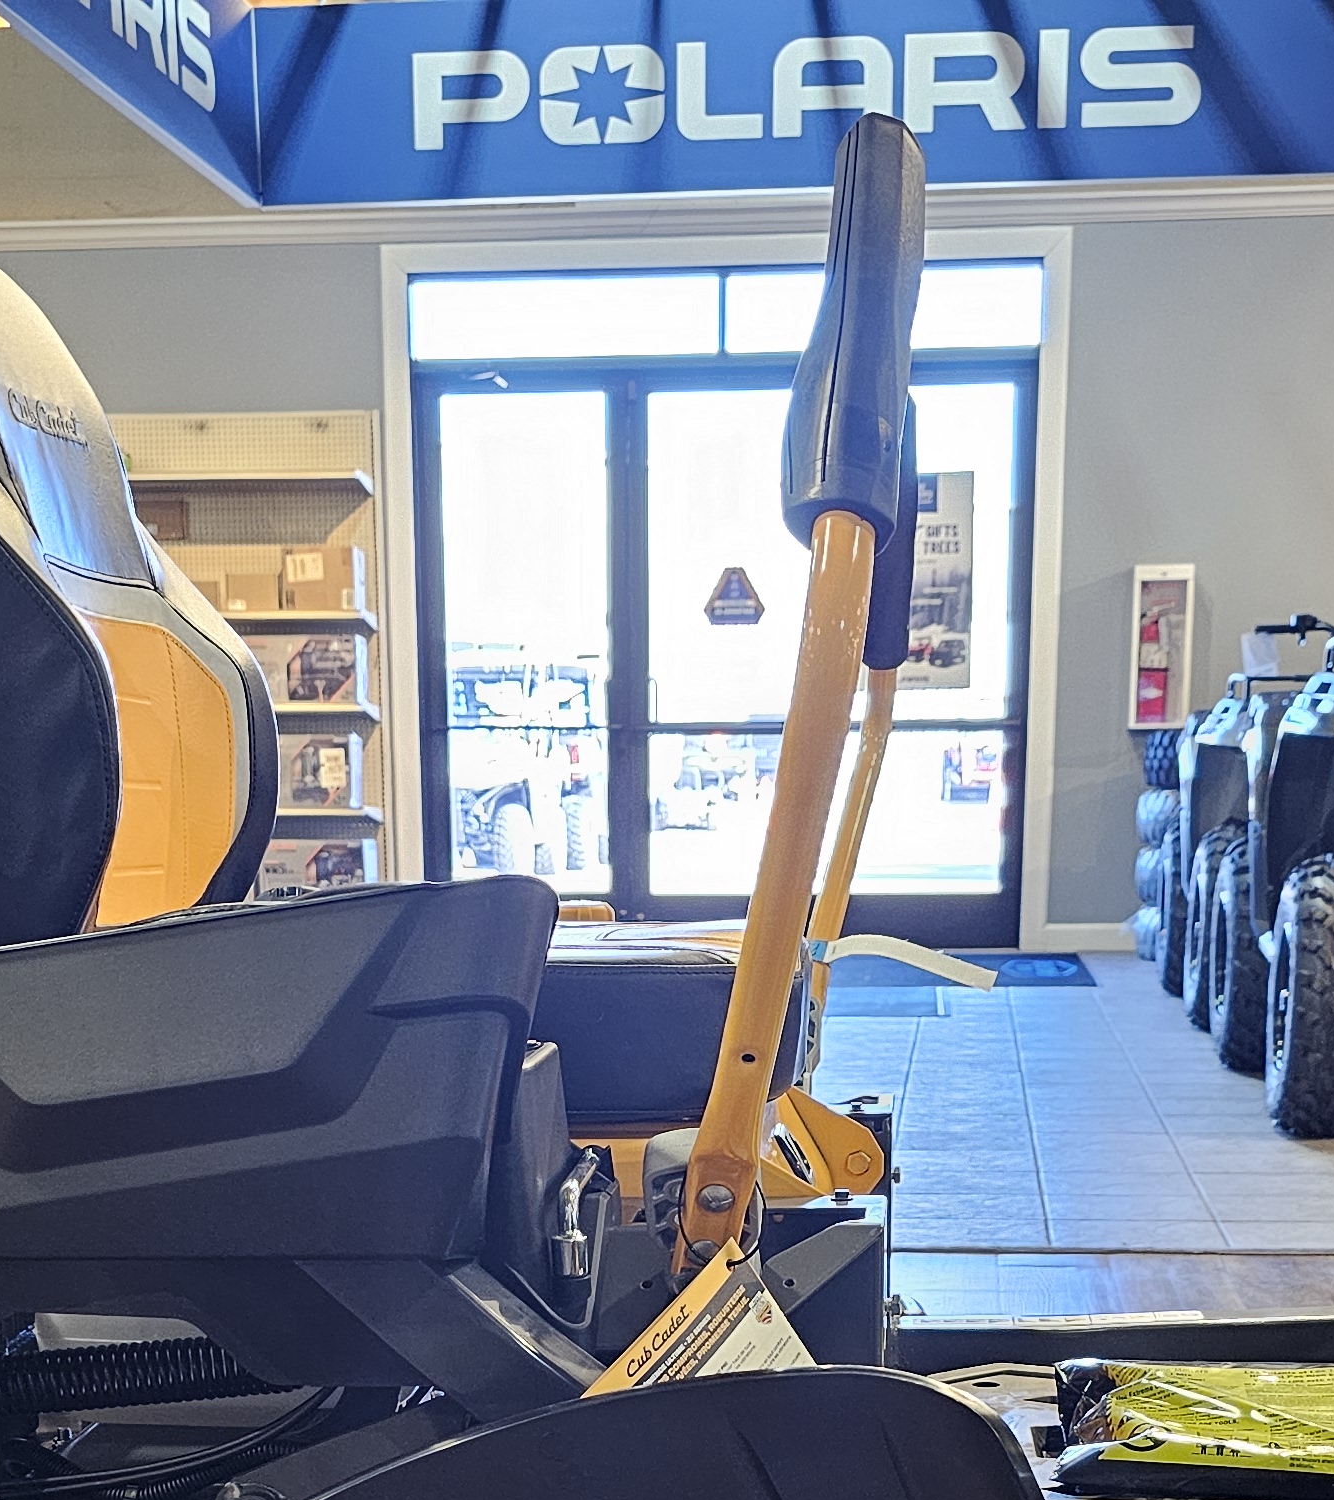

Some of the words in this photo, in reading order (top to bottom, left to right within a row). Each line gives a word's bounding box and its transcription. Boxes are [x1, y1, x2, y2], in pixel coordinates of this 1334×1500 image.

[78, 0, 215, 112] RIS
[412, 25, 1201, 150] POLARIS
[627, 1343, 652, 1378] Cub
[652, 1305, 691, 1351] Cadet
[669, 1330, 710, 1376] COMPROMIS,
[708, 1285, 746, 1332] ROBUSTESSE
[697, 1320, 731, 1360] PROMESSE
